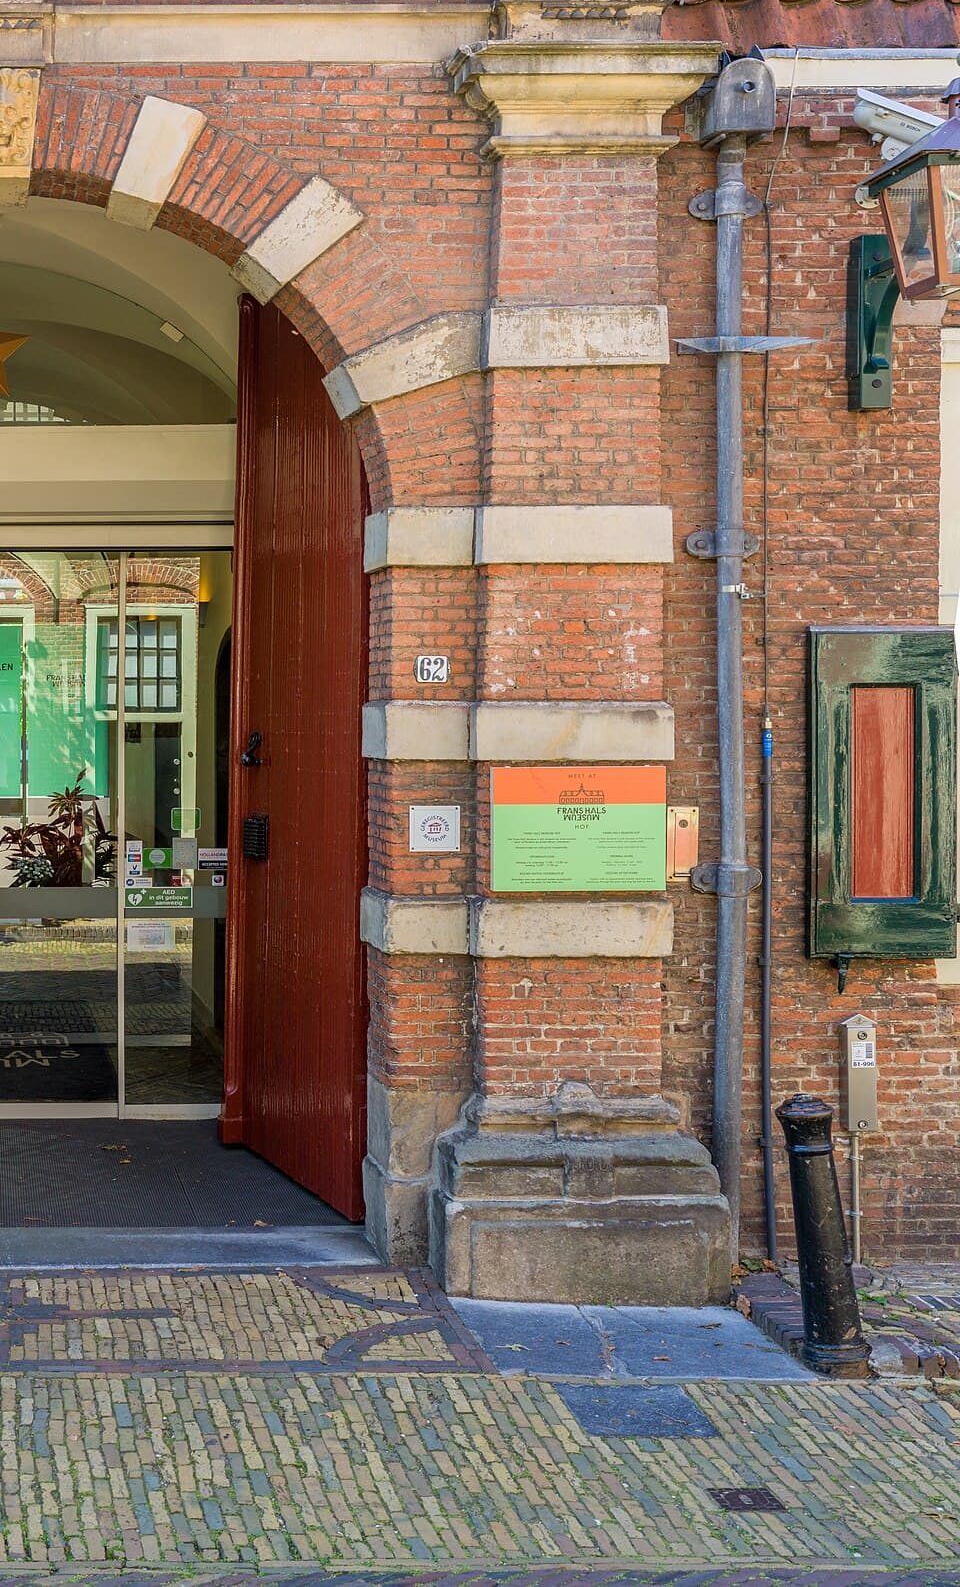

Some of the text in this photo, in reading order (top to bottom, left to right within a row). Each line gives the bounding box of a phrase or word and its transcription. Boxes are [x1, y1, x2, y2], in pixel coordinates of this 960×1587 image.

[419, 657, 445, 681] 62
[557, 807, 607, 815] FRANS HALS
[420, 815, 450, 832] GEREGISTREERD
[423, 833, 447, 842] MUSEUM
